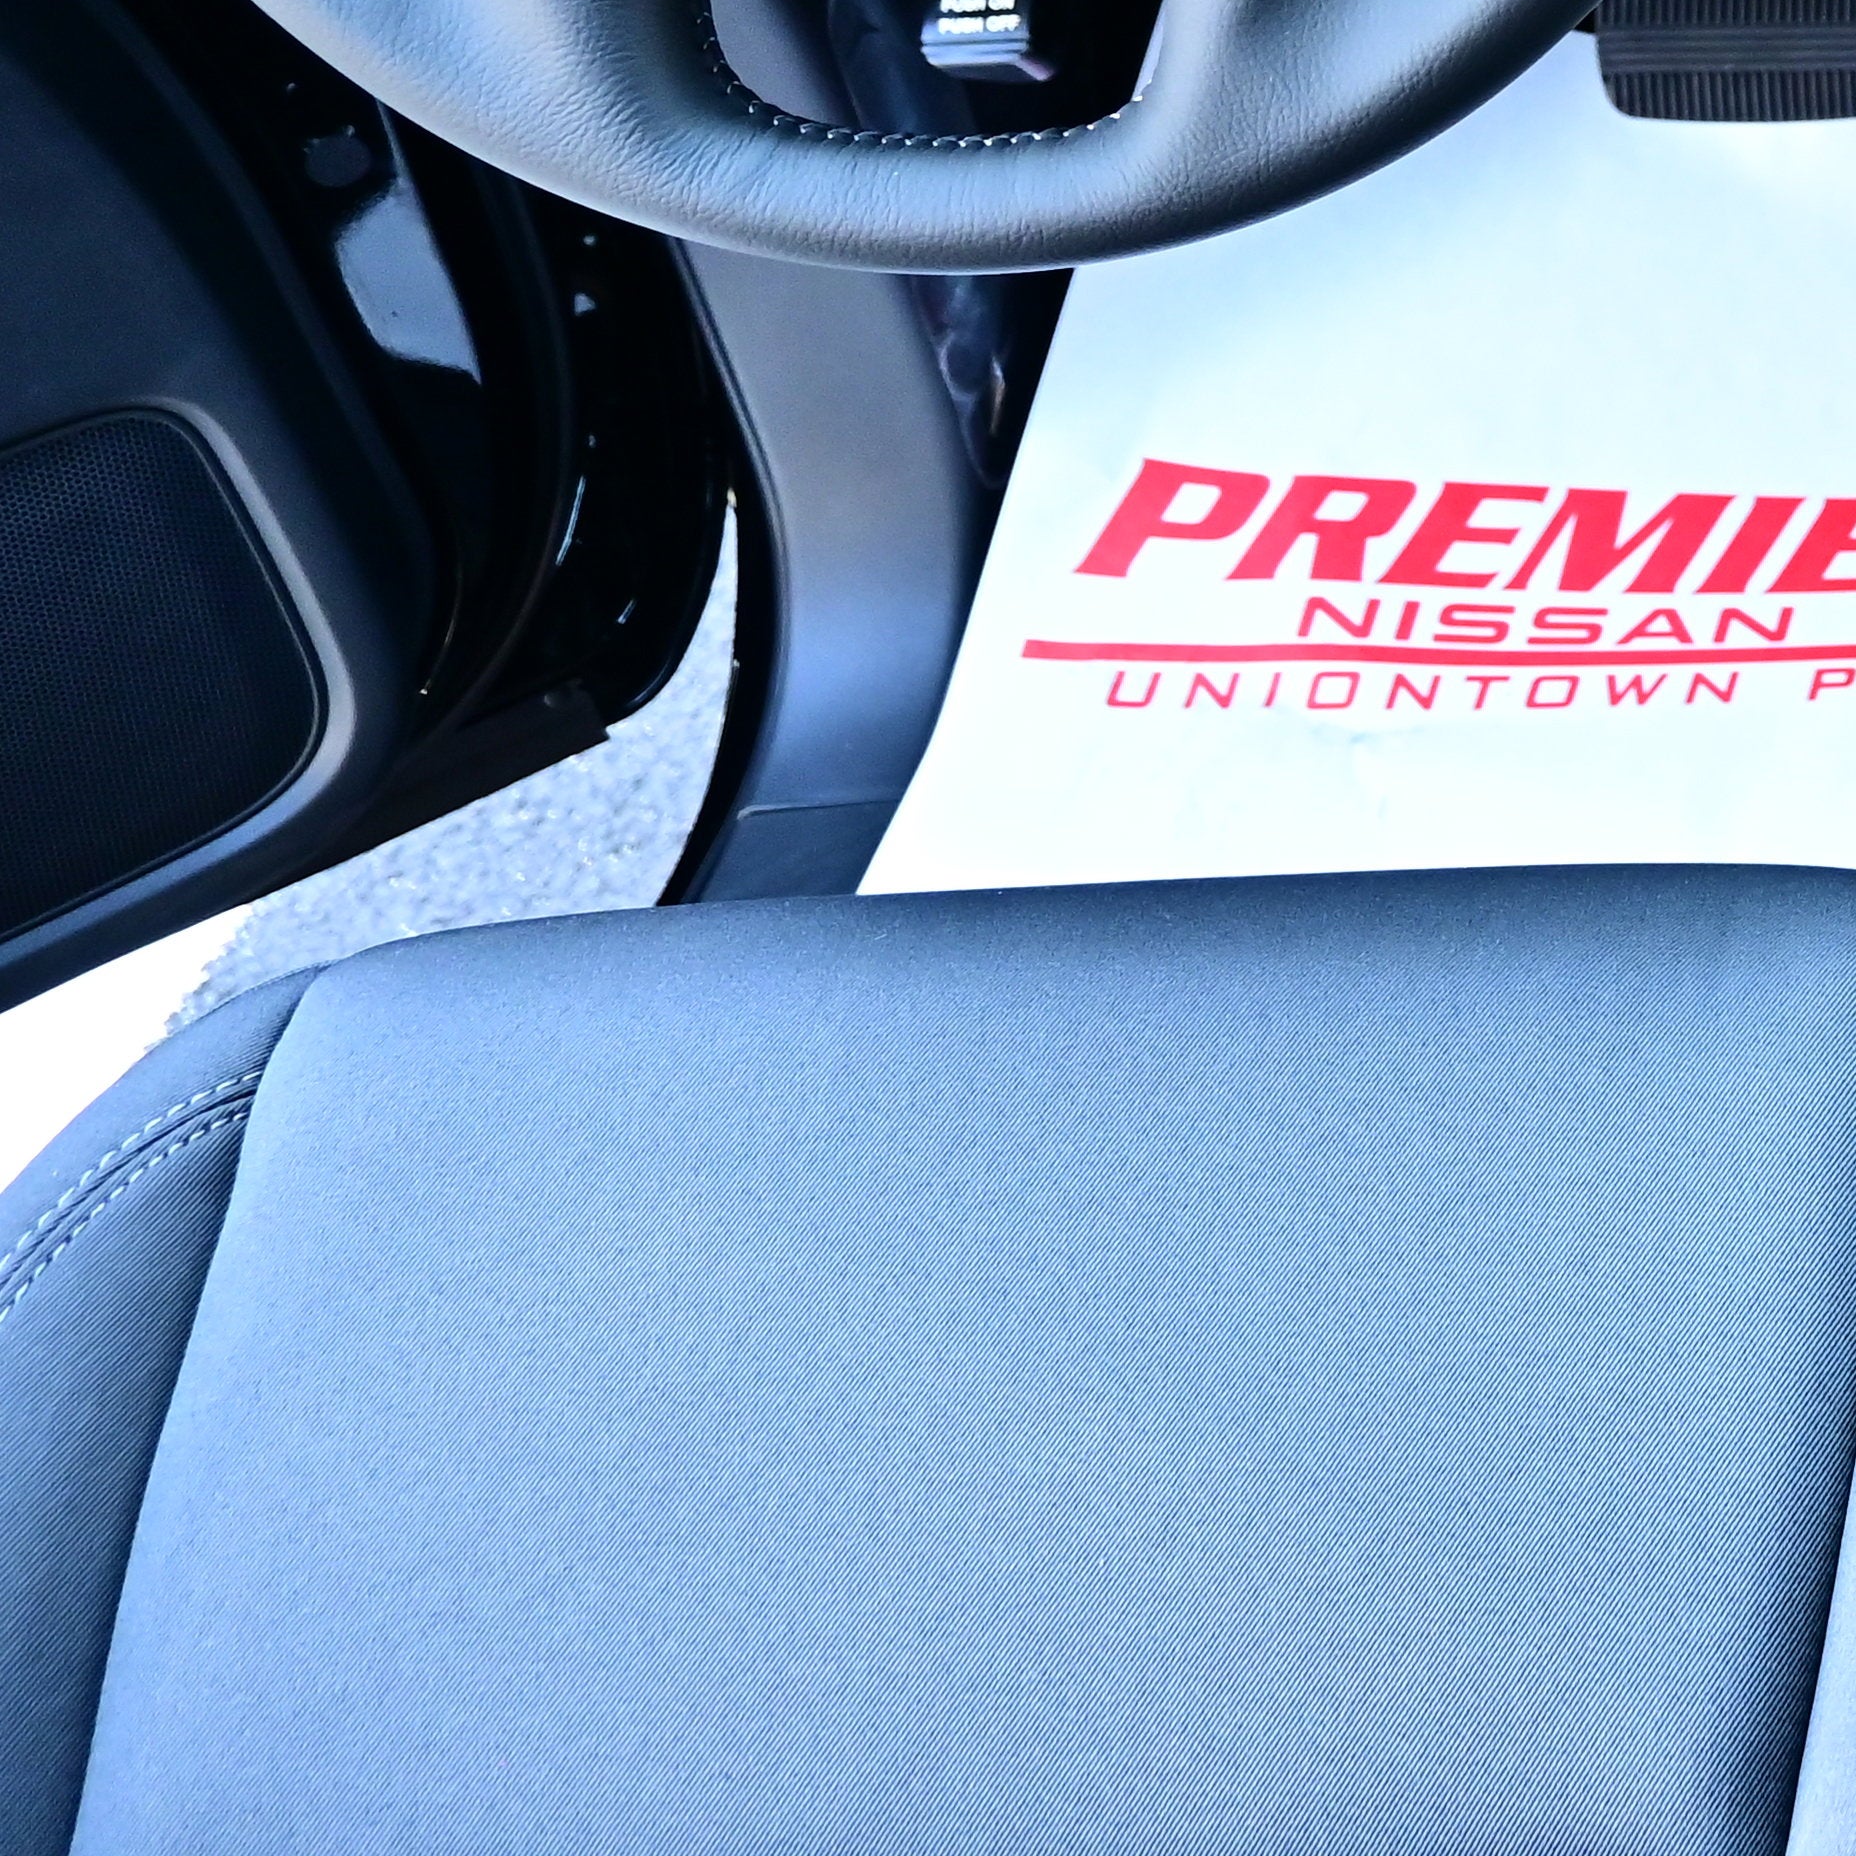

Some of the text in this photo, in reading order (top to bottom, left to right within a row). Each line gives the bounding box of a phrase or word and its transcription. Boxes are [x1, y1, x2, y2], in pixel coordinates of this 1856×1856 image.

[937, 17, 984, 35] PUSH
[1298, 595, 1794, 645] NISSAN
[1107, 668, 1741, 711] UNIONTOWN
